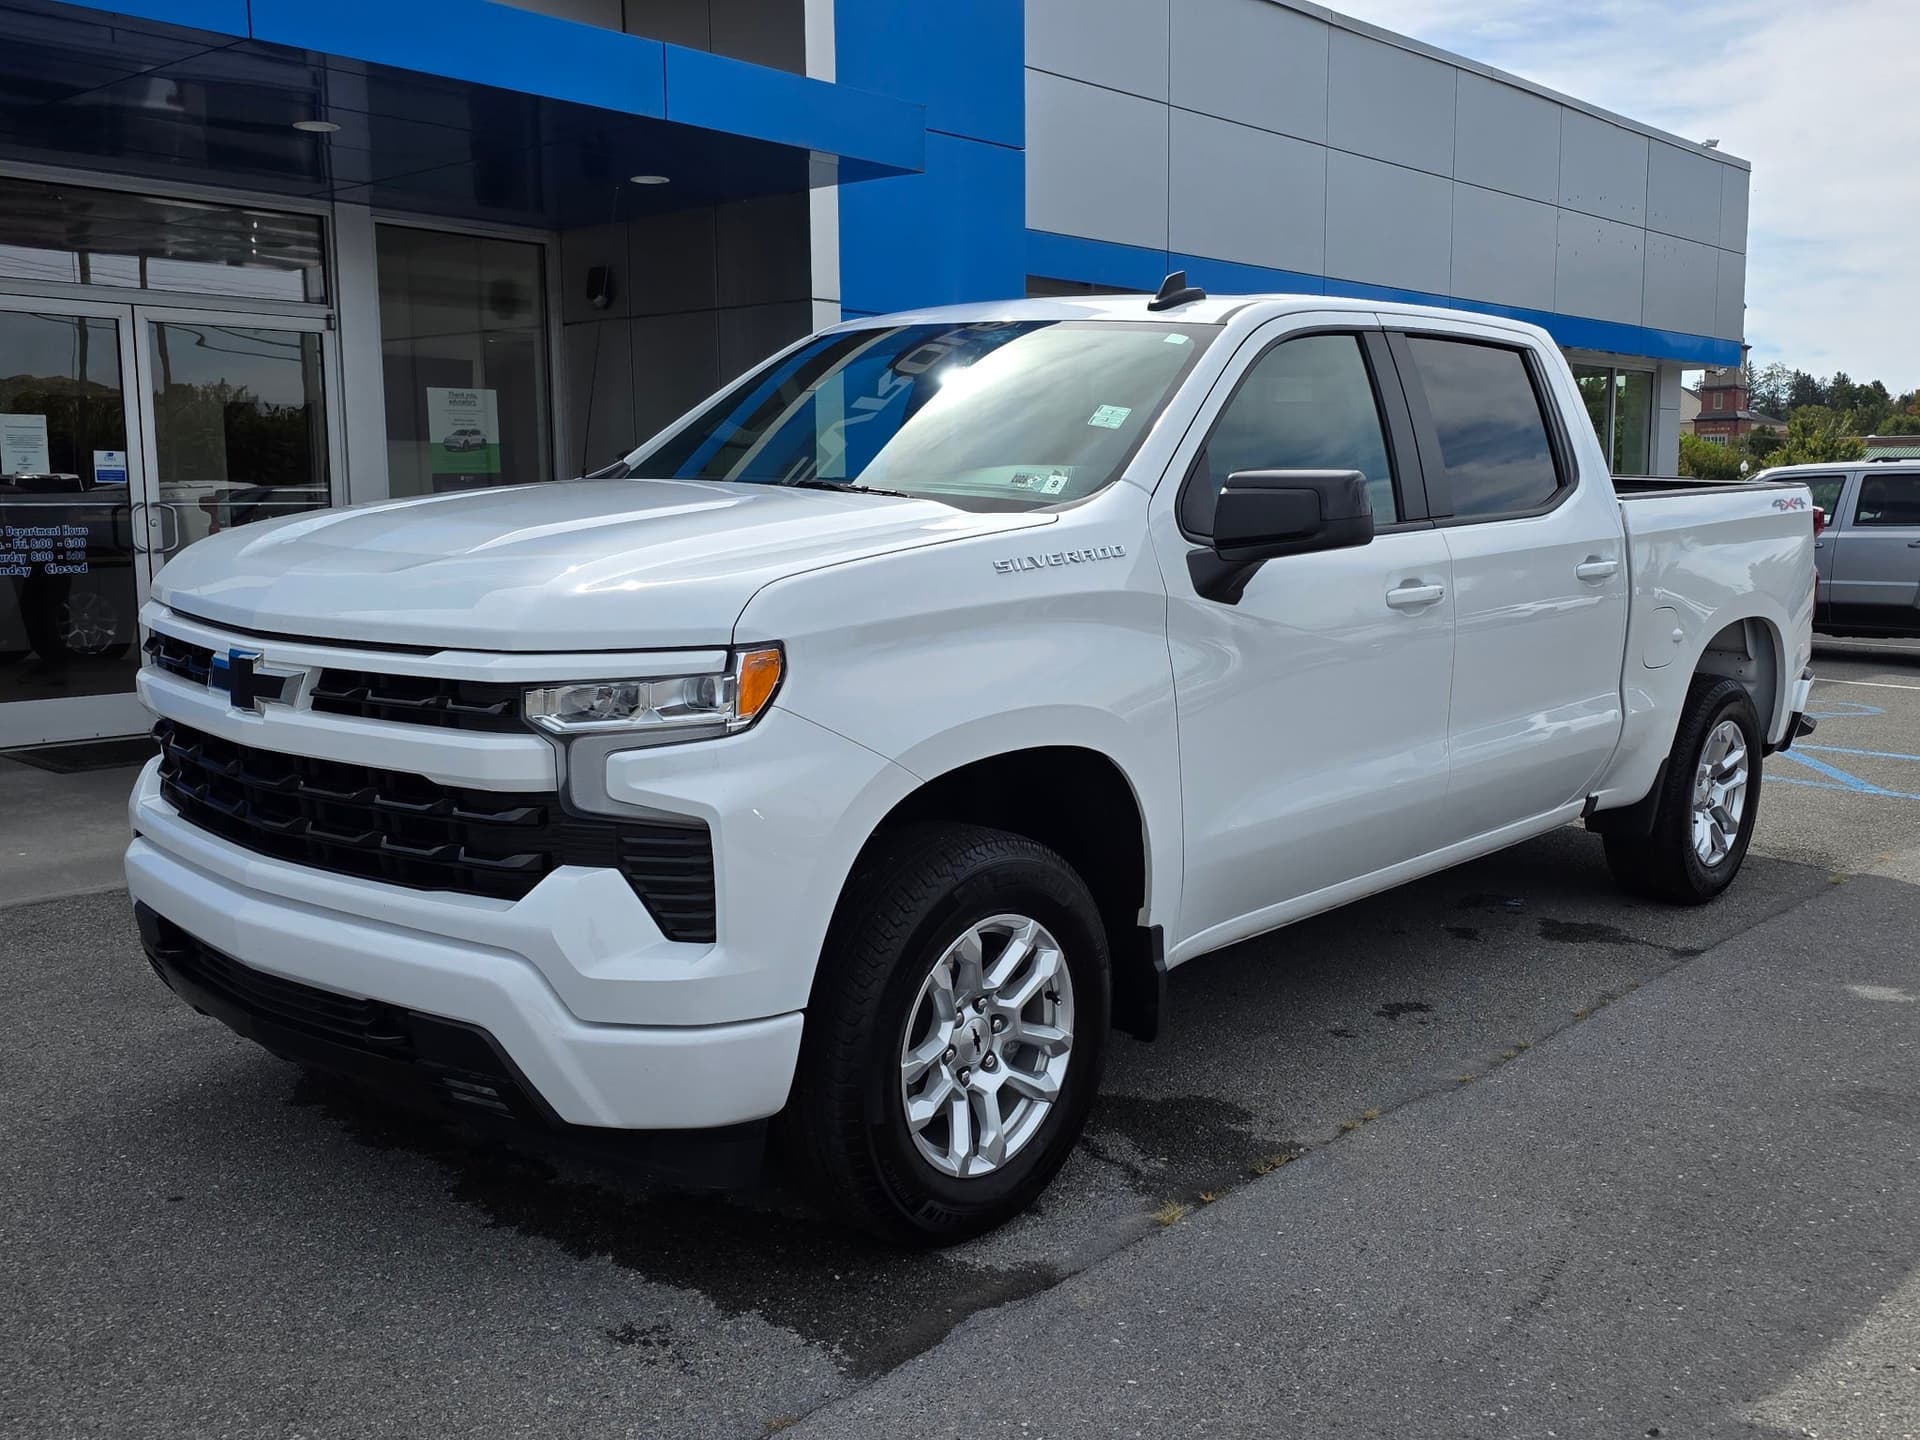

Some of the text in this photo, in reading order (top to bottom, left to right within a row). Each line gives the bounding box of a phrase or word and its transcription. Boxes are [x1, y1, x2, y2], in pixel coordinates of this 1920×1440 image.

[5, 525, 61, 539] Department
[62, 524, 89, 536] Hours
[30, 538, 53, 549] 8:00
[64, 537, 87, 548] 6:00
[31, 551, 54, 562] 8:00
[993, 544, 1127, 574] SILVERADO
[45, 562, 89, 575] Closed
